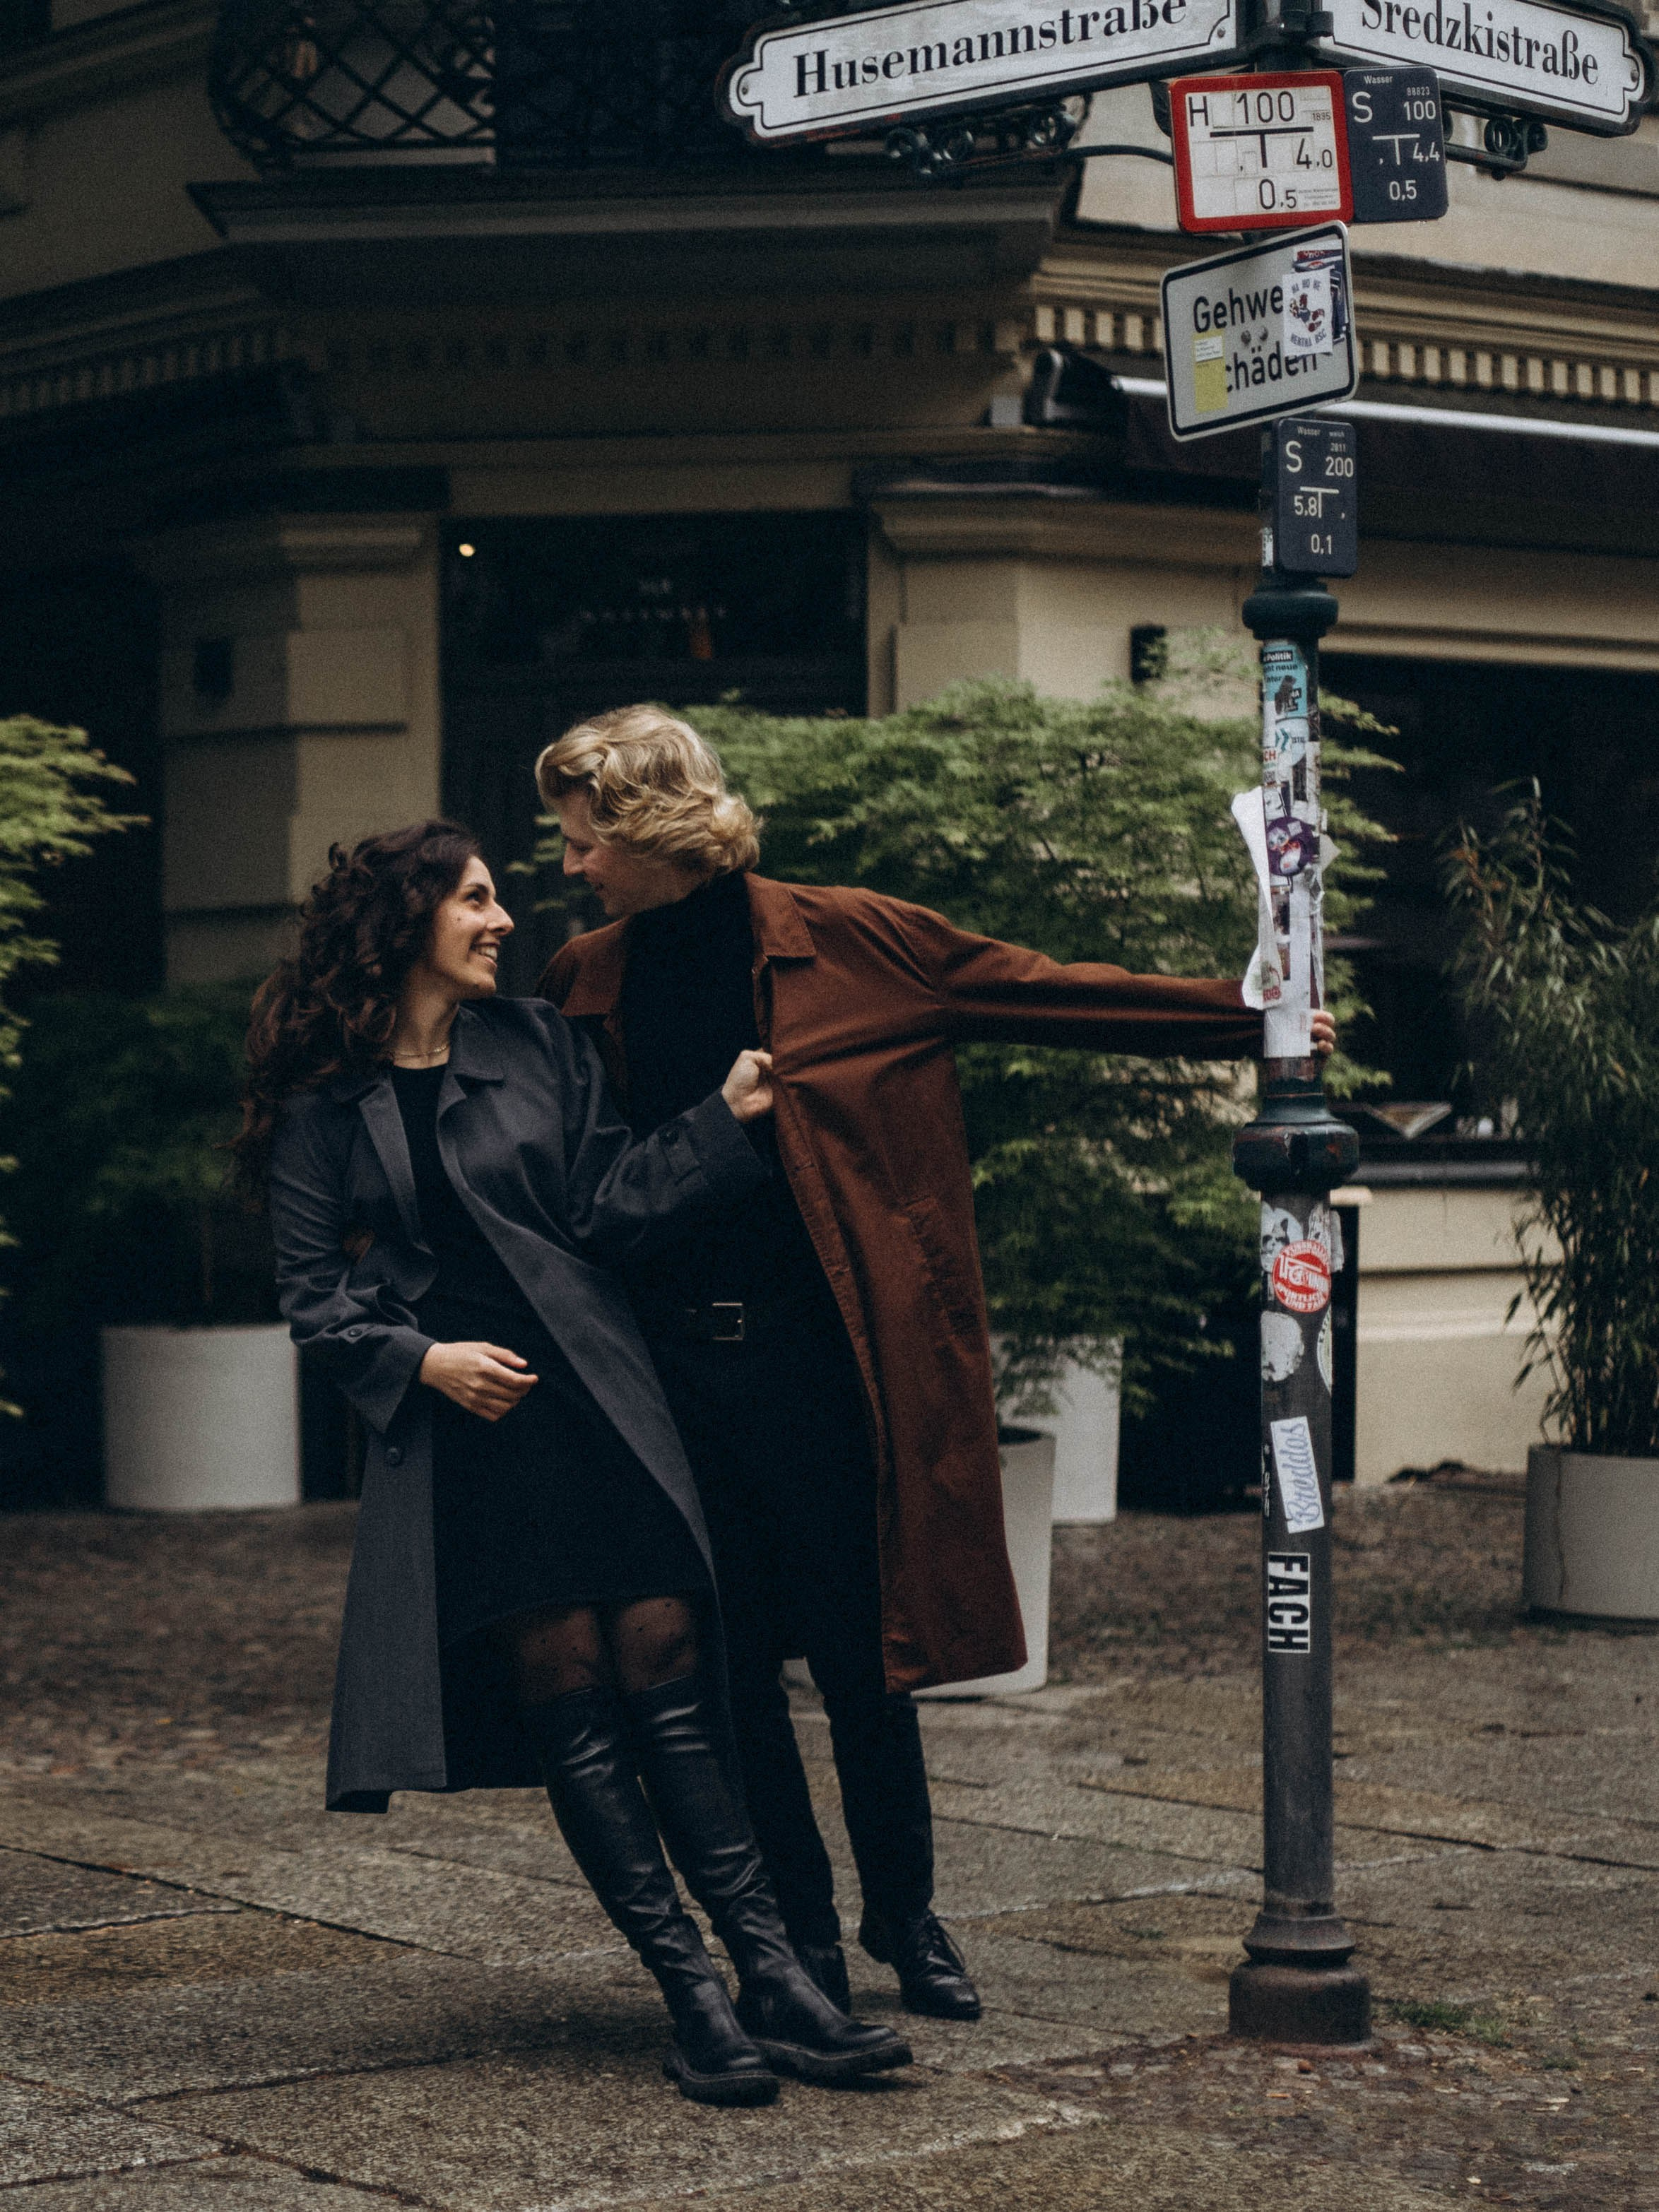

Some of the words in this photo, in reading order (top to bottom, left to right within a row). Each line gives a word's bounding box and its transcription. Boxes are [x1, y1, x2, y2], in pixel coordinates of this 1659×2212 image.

[792, 0, 1187, 98] Husemannstraße
[1363, 75, 1393, 84] Wasser
[1235, 90, 1294, 125] 100
[1351, 90, 1373, 123] S
[1403, 100, 1436, 121] 100
[1388, 179, 1417, 201] 0,5
[1193, 284, 1284, 333] Gehwe
[1297, 425, 1321, 437] Wasser
[1285, 440, 1302, 473] S
[1325, 456, 1354, 478] 200
[1268, 1554, 1309, 1652] FACH
